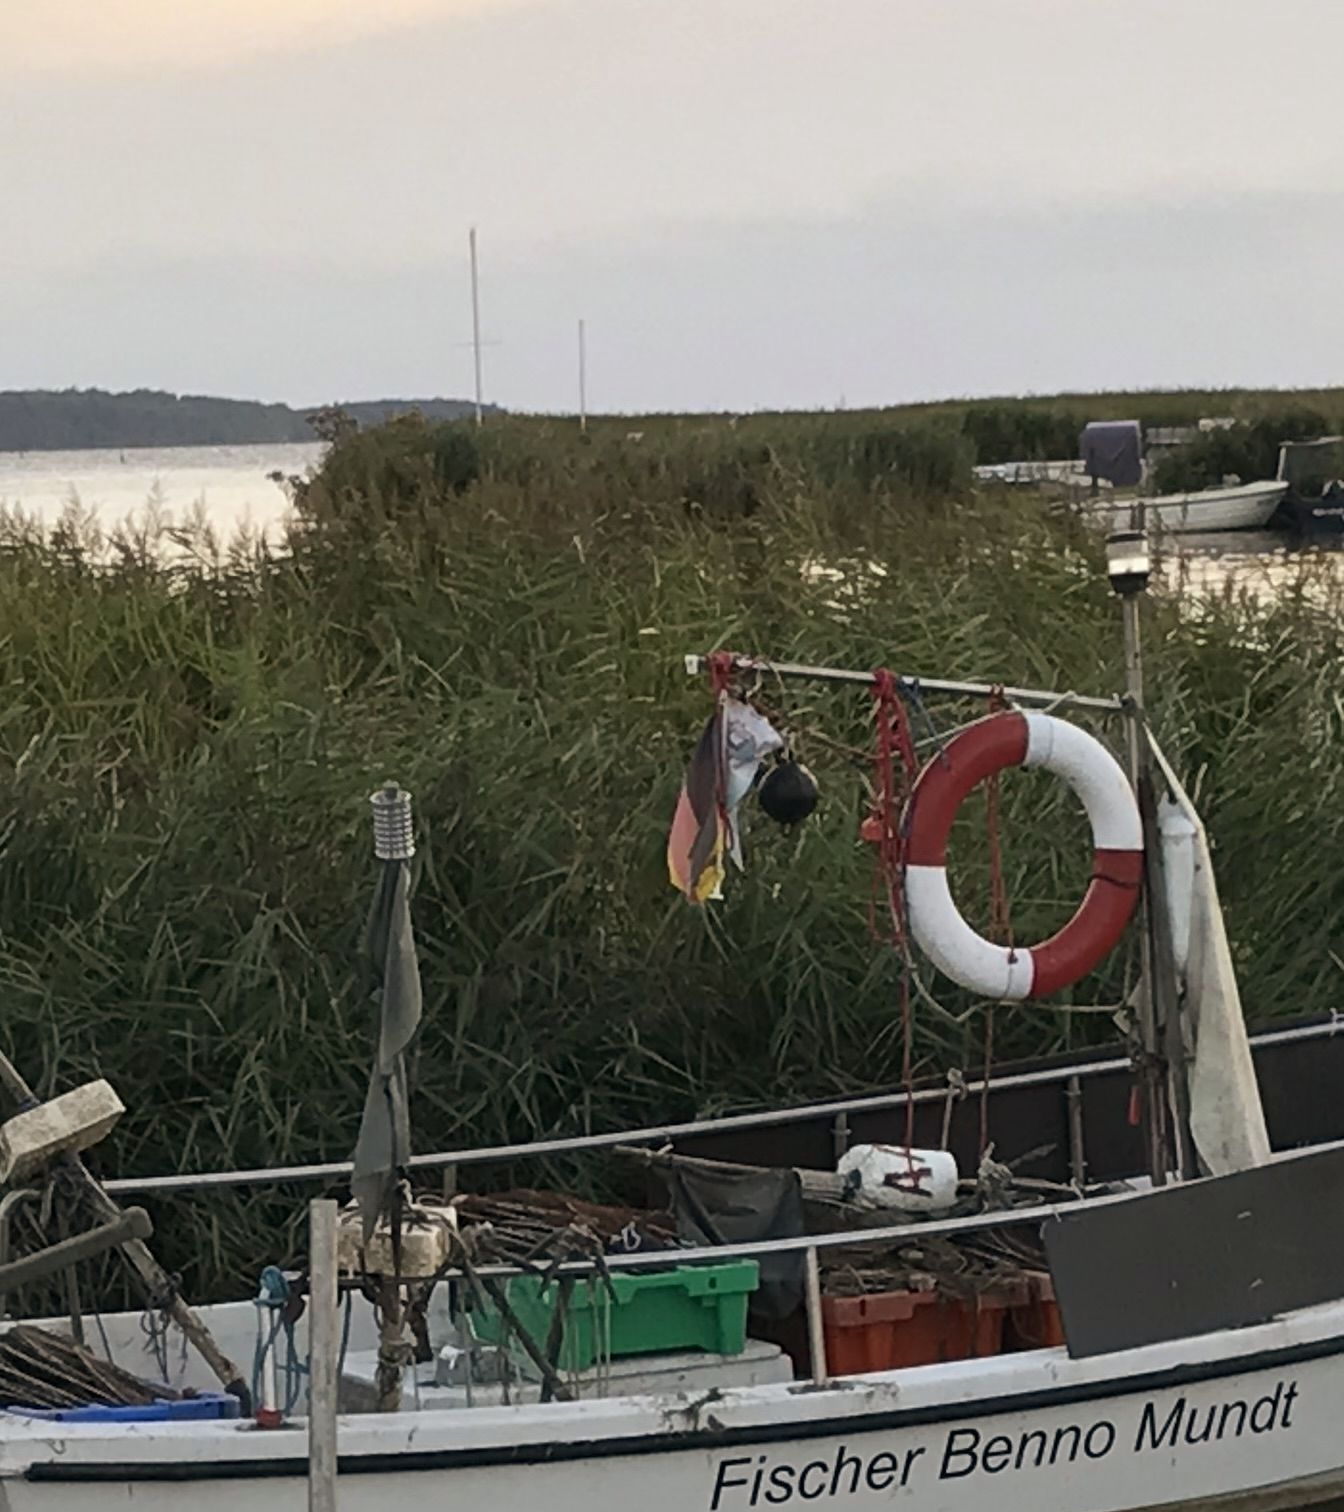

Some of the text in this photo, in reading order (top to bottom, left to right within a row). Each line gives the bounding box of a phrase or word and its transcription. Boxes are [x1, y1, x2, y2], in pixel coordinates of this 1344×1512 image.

[710, 1380, 1300, 1511] Fischer Benno Mundt
